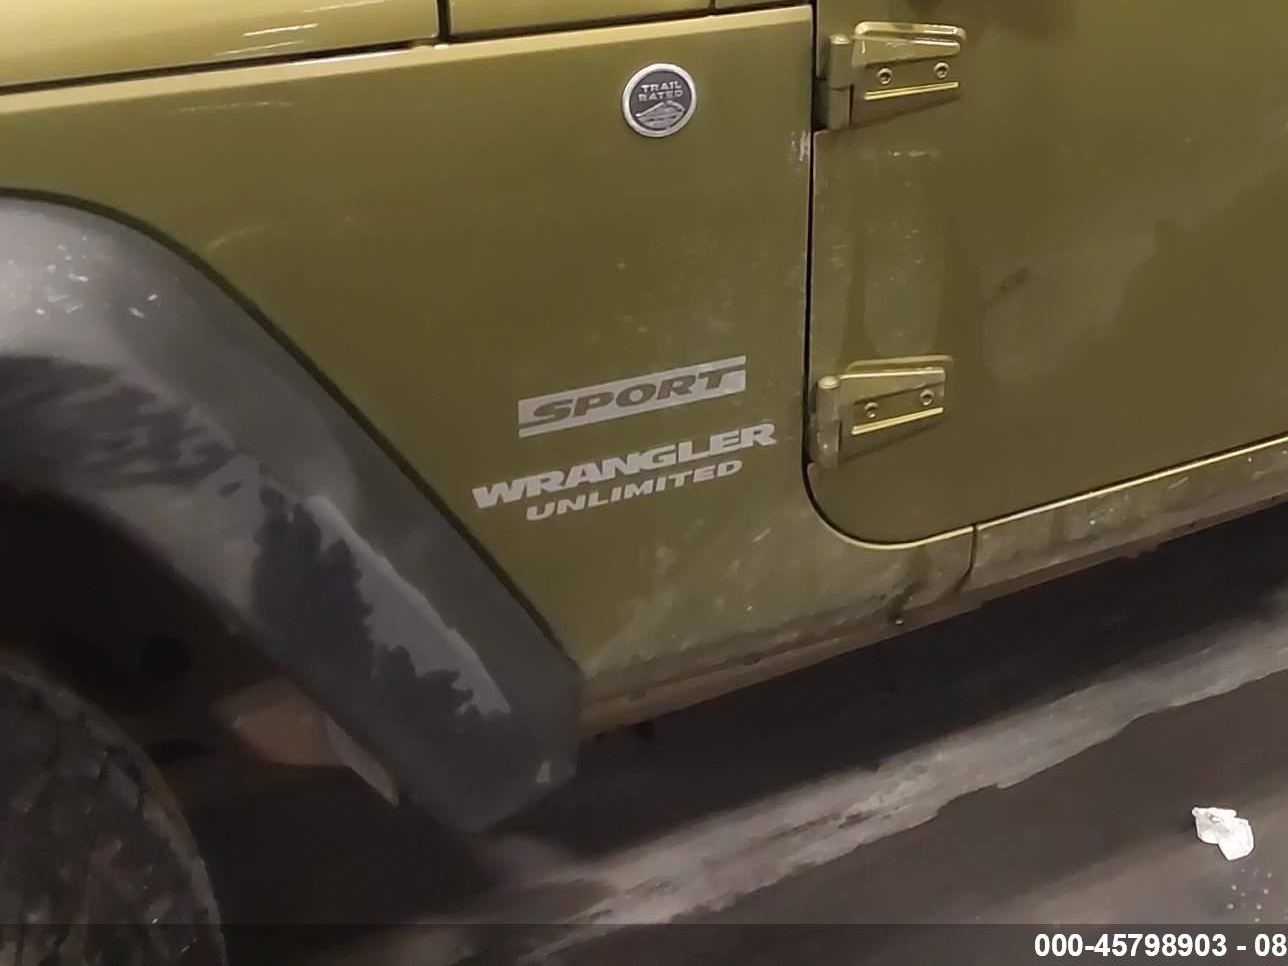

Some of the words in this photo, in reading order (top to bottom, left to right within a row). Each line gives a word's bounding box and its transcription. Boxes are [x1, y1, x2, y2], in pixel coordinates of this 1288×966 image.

[638, 89, 684, 102] RATED
[640, 80, 682, 93] TRAIL
[531, 366, 736, 425] SPORT
[471, 422, 778, 510] WRANGLER
[525, 459, 744, 522] UNLIMITED
